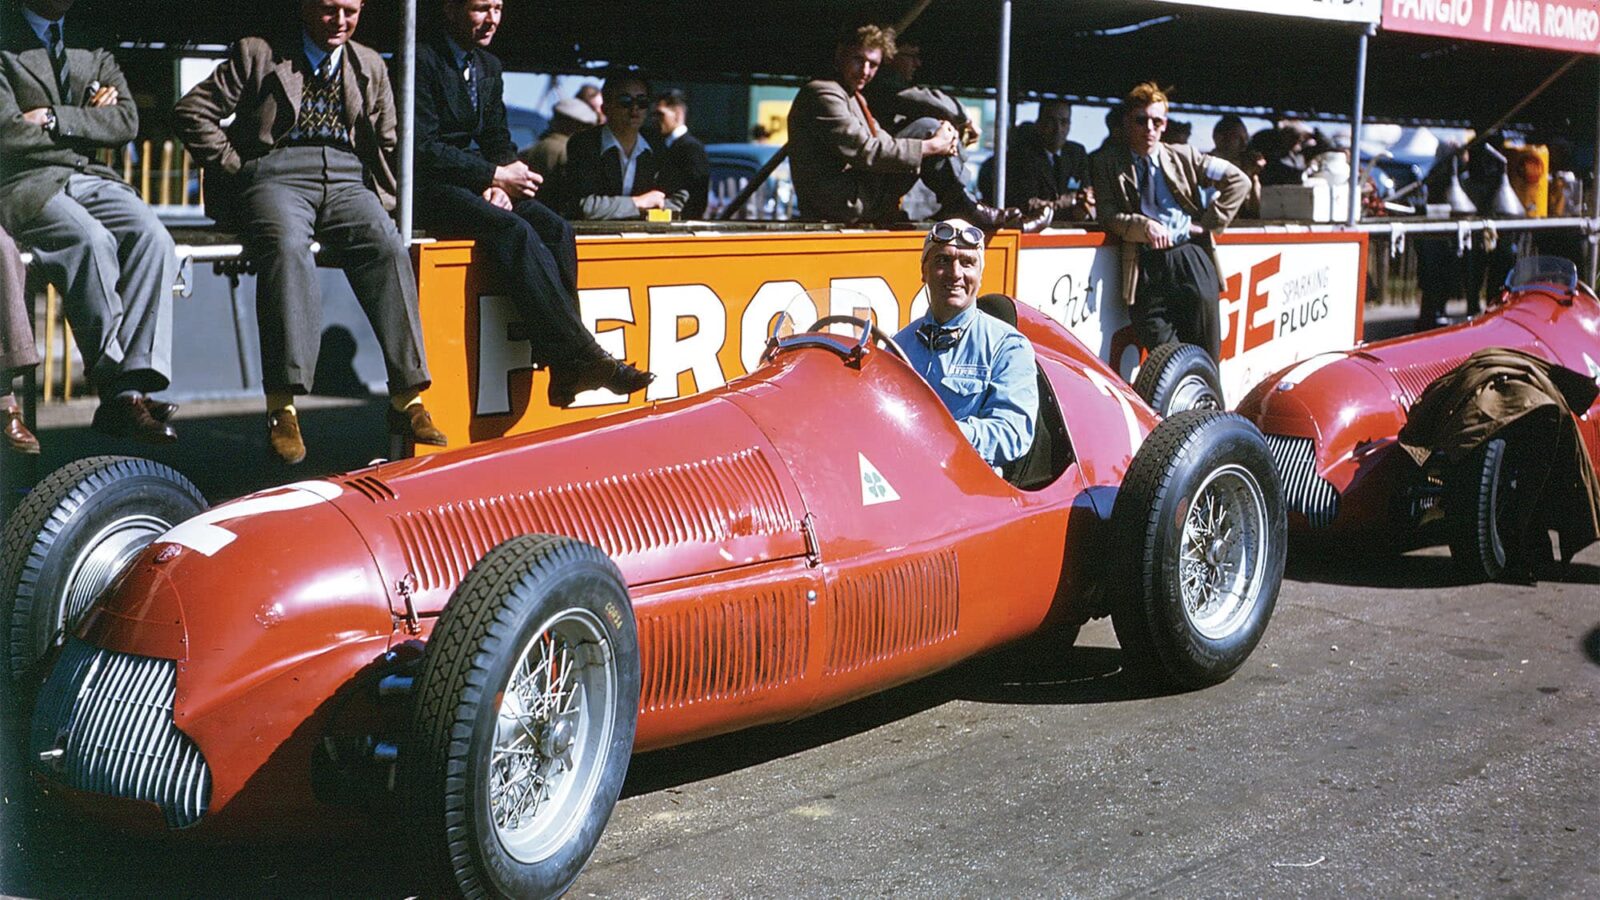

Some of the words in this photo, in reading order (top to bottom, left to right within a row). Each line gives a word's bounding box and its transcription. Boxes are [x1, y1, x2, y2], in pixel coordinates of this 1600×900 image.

[1502, 1, 1541, 35] ALFA
[1544, 5, 1599, 41] ROMEO
[1051, 273, 1094, 328] Fit
[1282, 266, 1329, 305] SPARKING
[1279, 294, 1329, 337] PLUGS
[476, 276, 930, 416] FEROD
